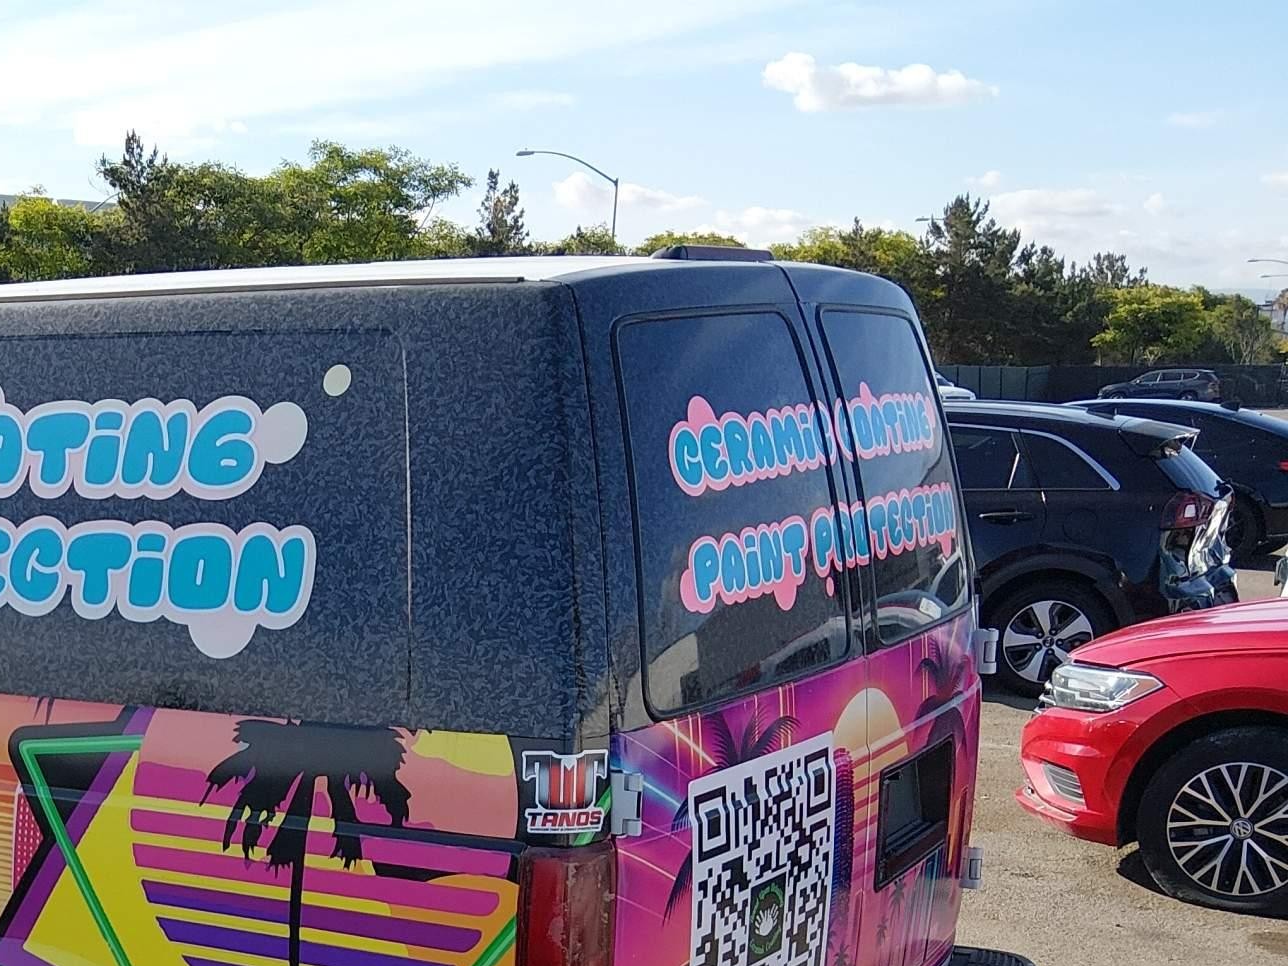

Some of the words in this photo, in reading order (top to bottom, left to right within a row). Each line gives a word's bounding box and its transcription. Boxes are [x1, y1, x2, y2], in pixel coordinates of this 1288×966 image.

[672, 404, 833, 488] CERAMIC
[691, 520, 807, 602] PAINT
[527, 810, 602, 828] TANOS
